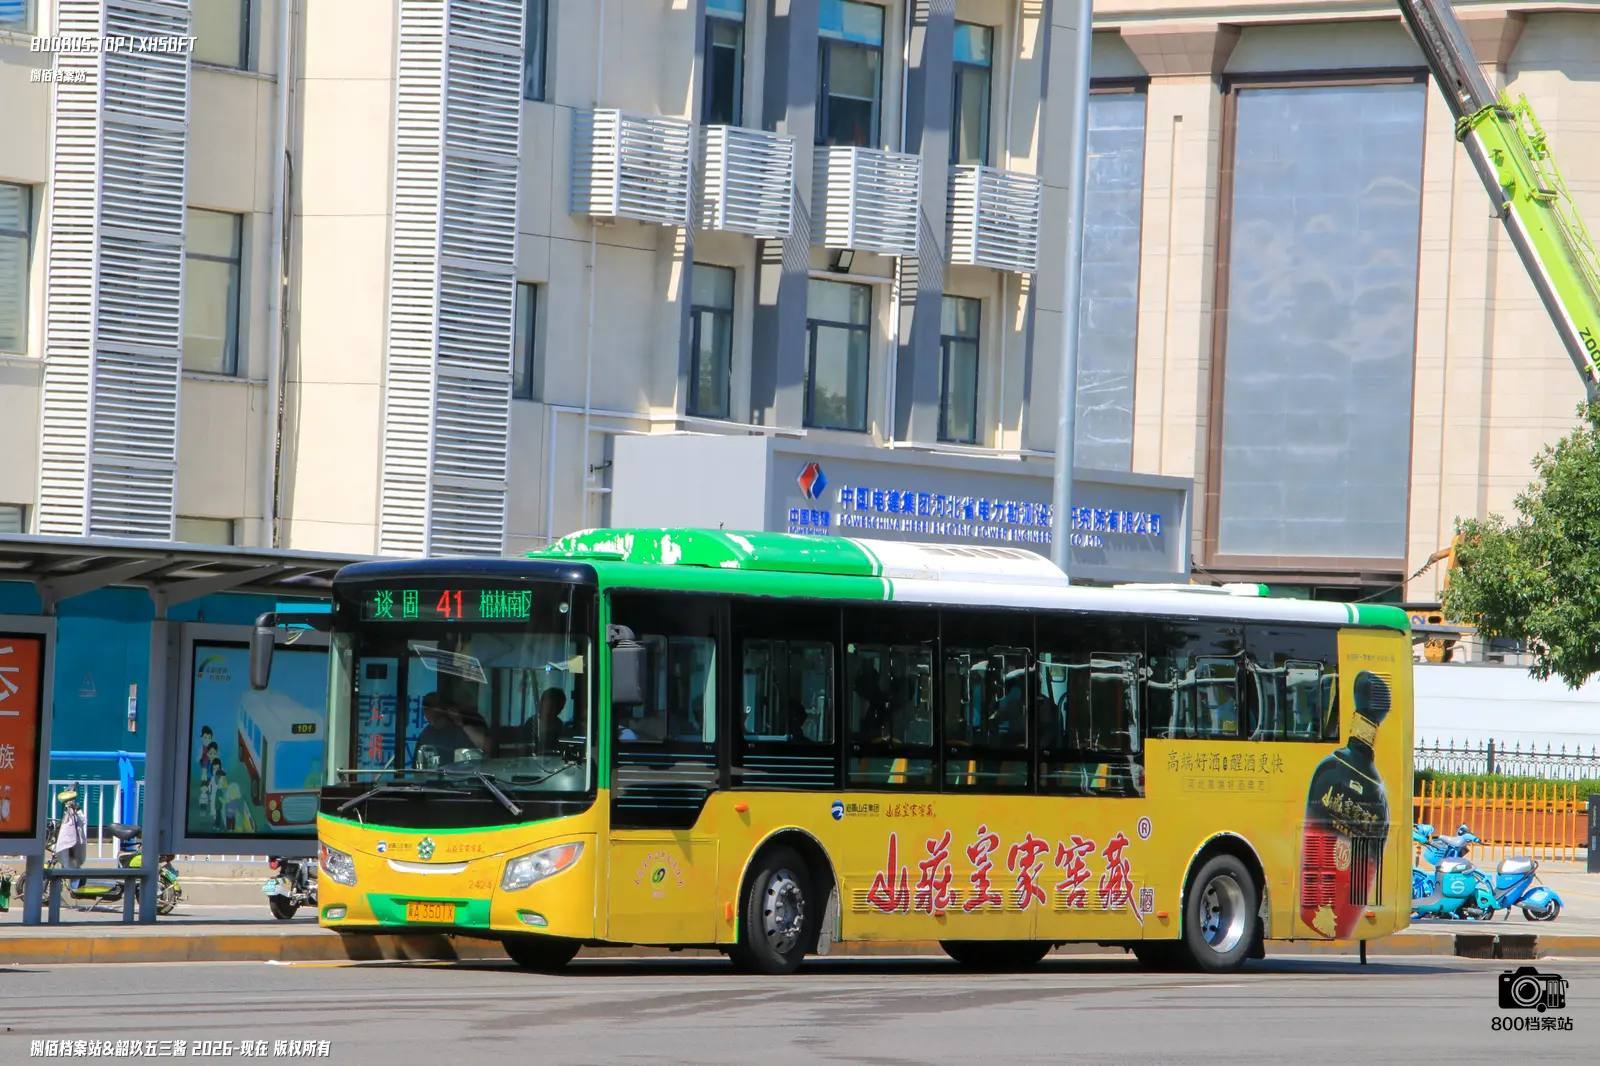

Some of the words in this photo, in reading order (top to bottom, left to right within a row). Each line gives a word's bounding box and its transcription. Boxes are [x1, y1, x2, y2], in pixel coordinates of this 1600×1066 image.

[788, 508, 830, 527] 中国电建
[838, 485, 1161, 536] 中国电建集团河北省电力勘测设究院有限公司
[837, 513, 901, 531] POWERCHINA
[974, 525, 1008, 540] POWER
[1007, 528, 1053, 544] ENGINEER
[374, 590, 419, 618] 谈固
[436, 590, 462, 618] 41
[479, 590, 532, 618] 柏林南区
[297, 724, 313, 733] 101
[468, 880, 493, 890] 2424
